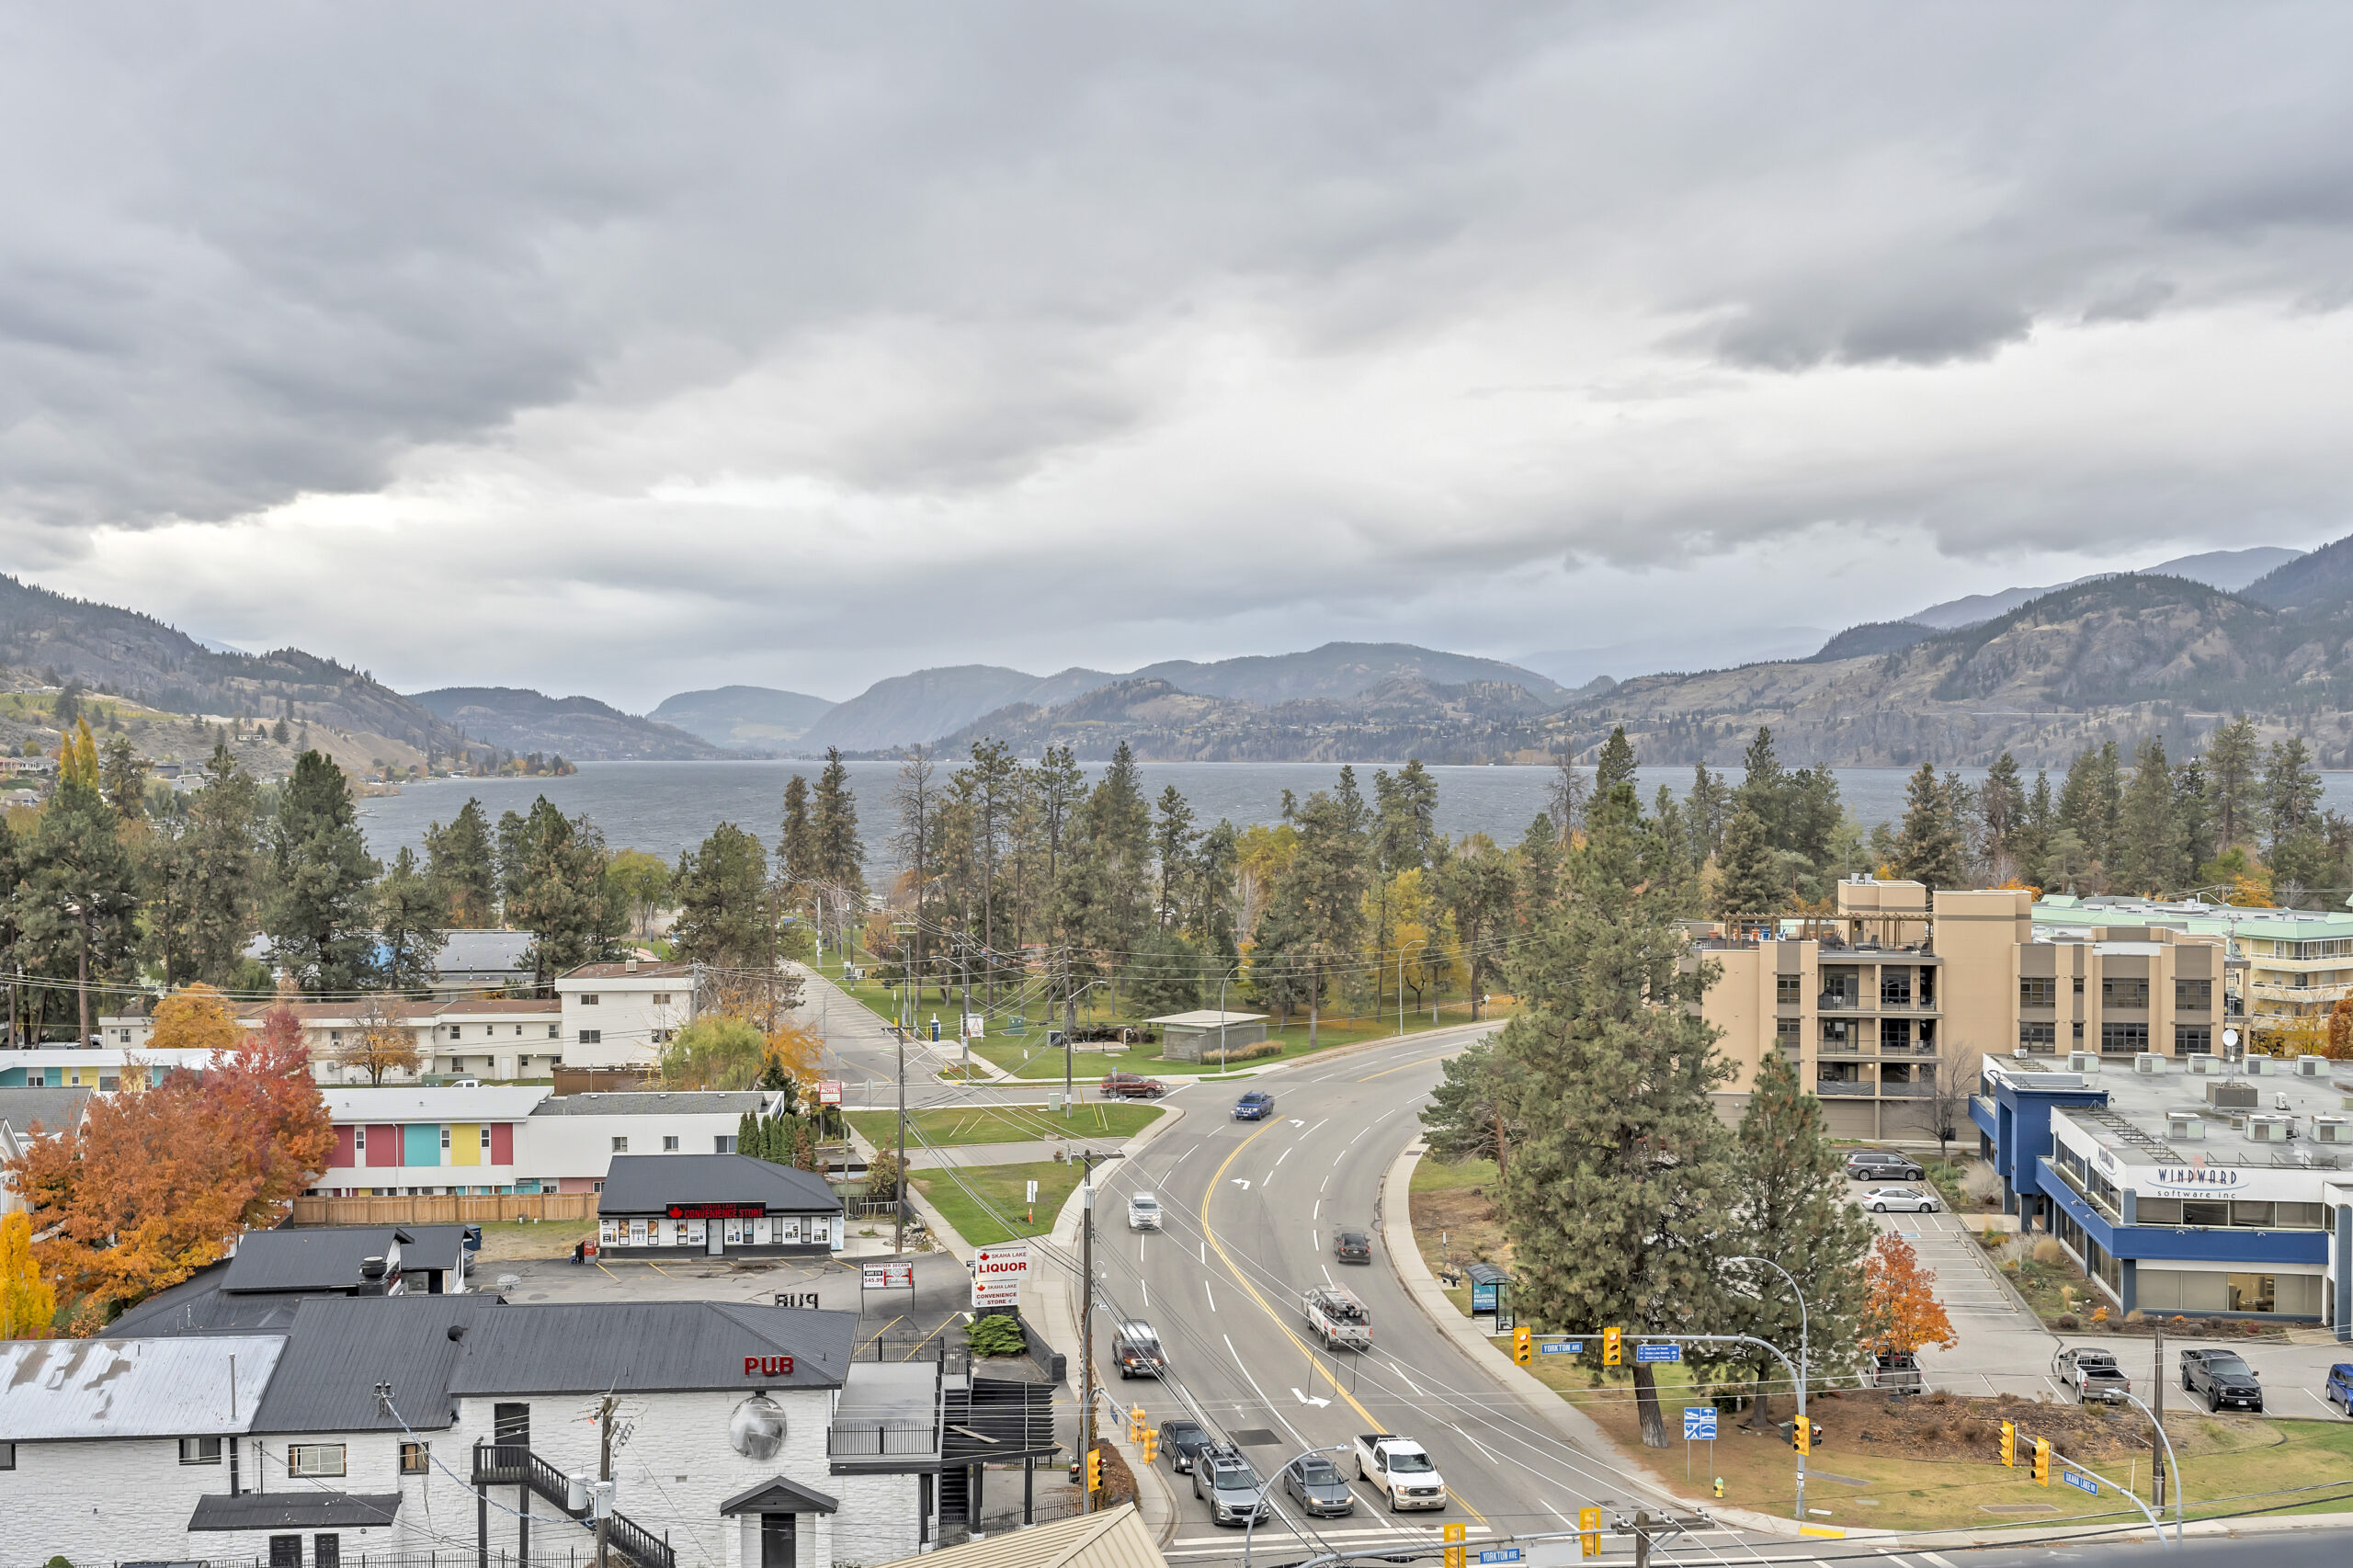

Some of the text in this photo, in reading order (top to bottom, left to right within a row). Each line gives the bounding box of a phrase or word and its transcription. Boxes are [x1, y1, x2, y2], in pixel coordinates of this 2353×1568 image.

[2158, 1169, 2237, 1185] WINDWARD
[2157, 1190, 2211, 1199] software
[684, 1208, 764, 1219] CONVENIENCE STORE
[979, 1262, 1028, 1273] LIQUOR
[976, 1291, 1017, 1300] CONVENIENCE
[1544, 1344, 1571, 1353] YORKTON
[744, 1356, 795, 1376] PUB
[2080, 1478, 2091, 1491] LAKE
[1483, 1551, 1508, 1562] YORKTON
